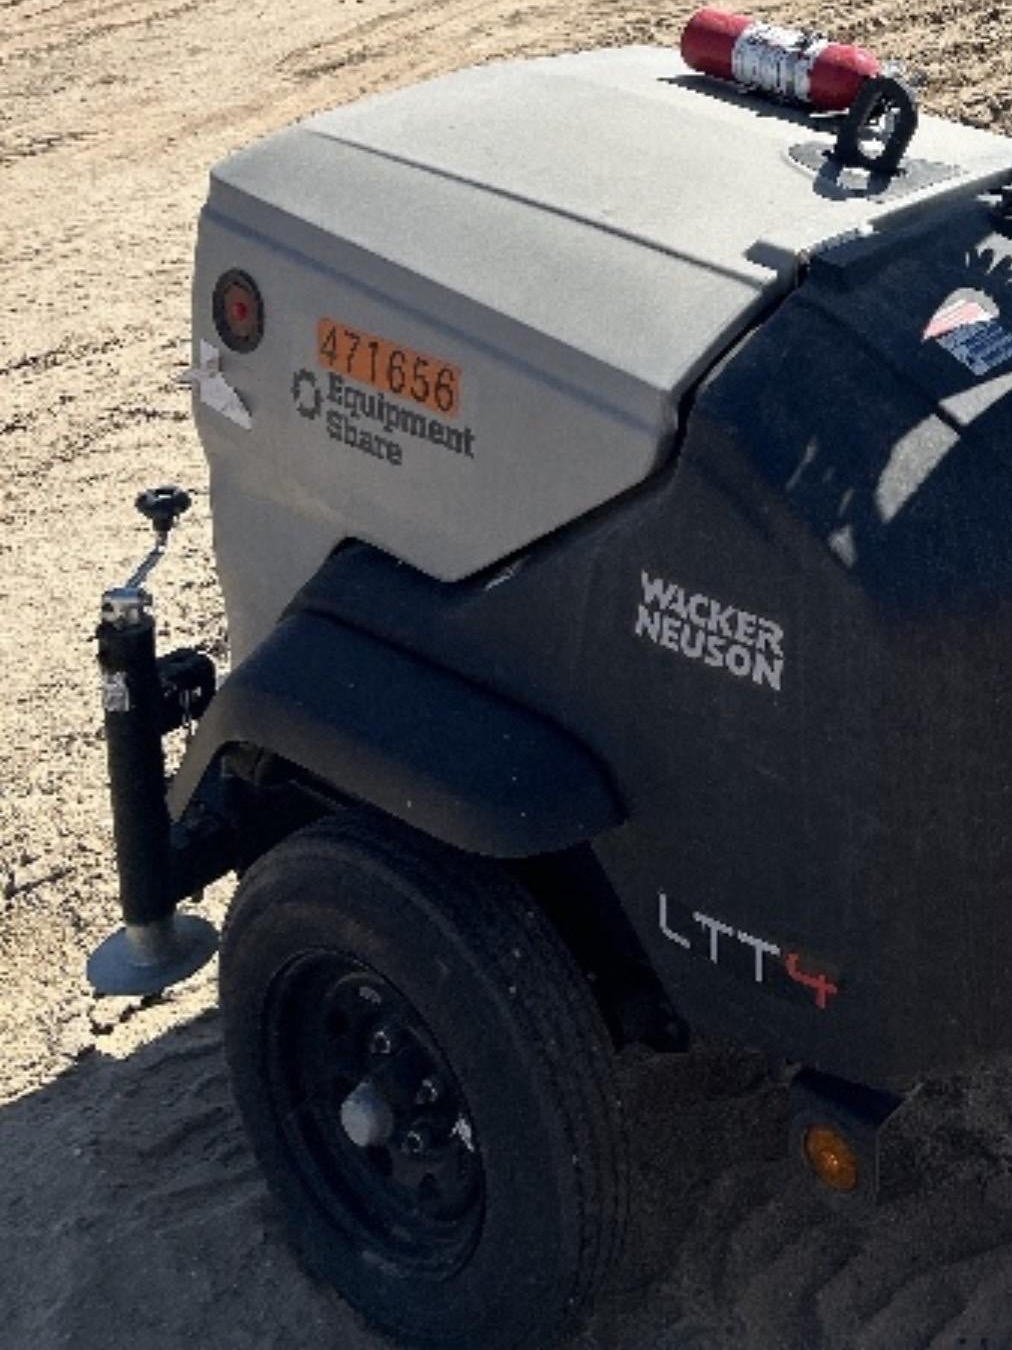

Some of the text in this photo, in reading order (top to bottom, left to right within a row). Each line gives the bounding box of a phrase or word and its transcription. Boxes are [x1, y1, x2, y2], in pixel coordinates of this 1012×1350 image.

[318, 325, 457, 413] 471656
[326, 370, 476, 459] Equipment
[326, 411, 403, 466] Share
[635, 604, 784, 692] NEUSON
[641, 569, 784, 658] WACKER
[658, 892, 838, 1008] LTT4
